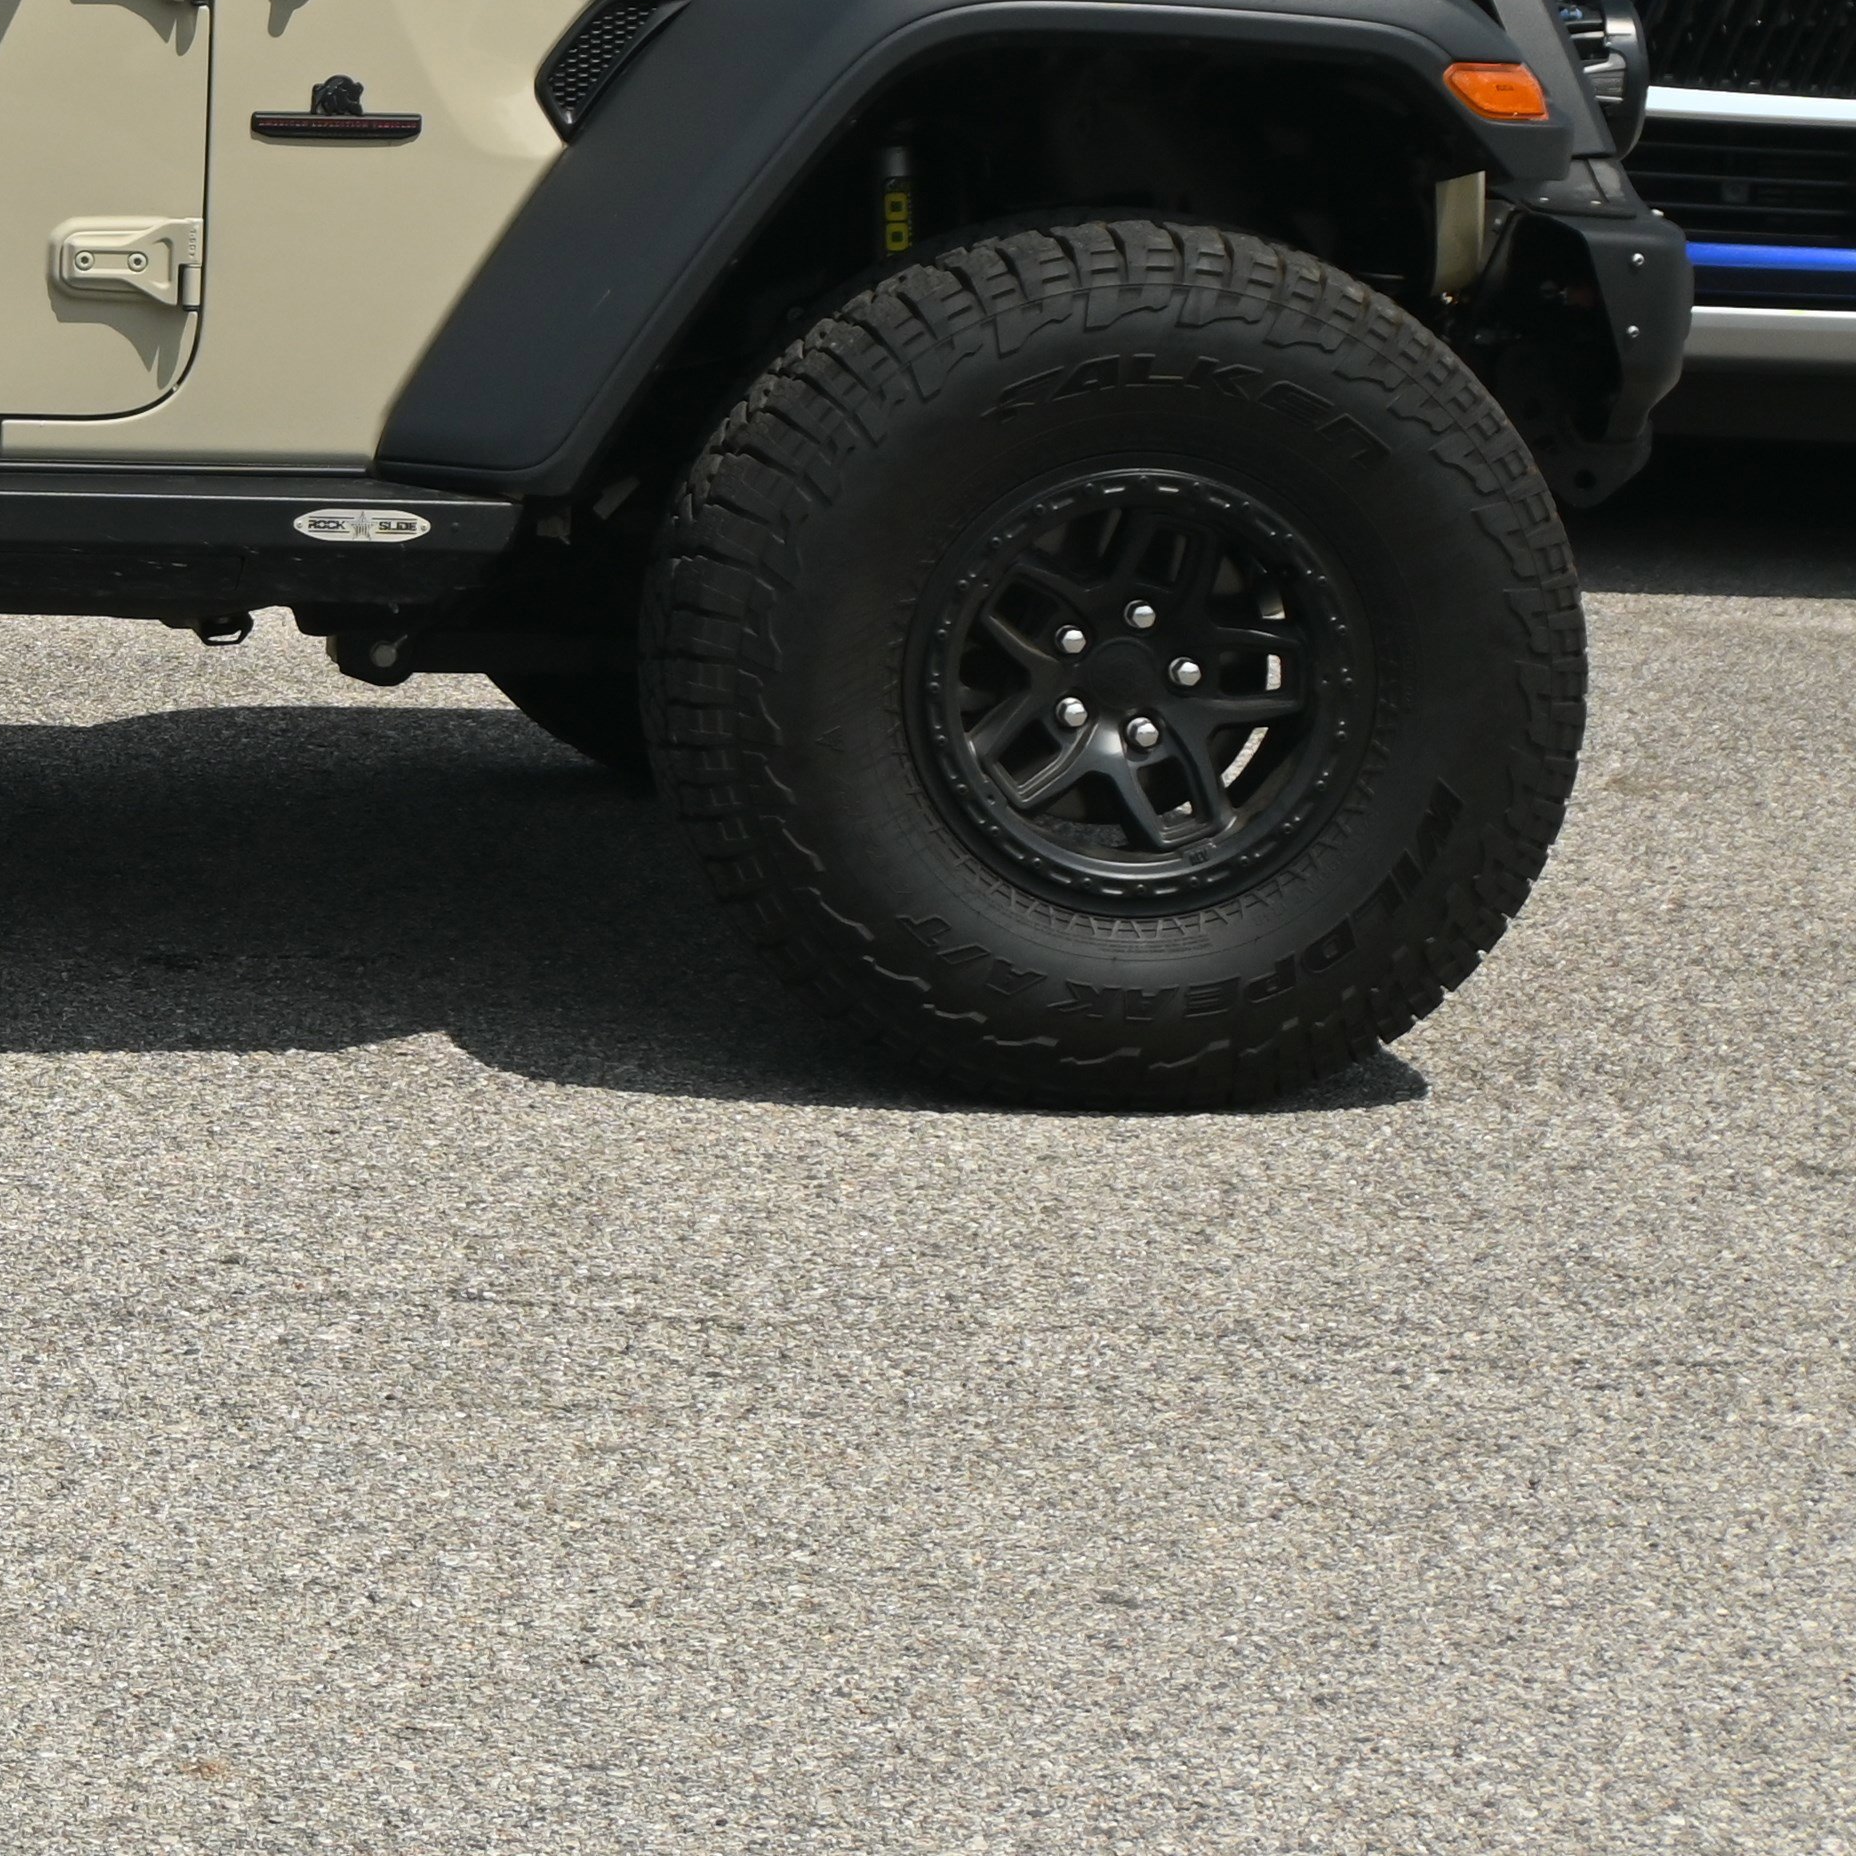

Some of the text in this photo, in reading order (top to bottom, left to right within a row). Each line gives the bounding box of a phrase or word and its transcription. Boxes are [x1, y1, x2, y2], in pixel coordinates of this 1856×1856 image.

[980, 353, 1391, 470] FALKEN
[308, 520, 417, 531] ROCK SLIDE
[1047, 777, 1464, 1022] WILDPEAK
